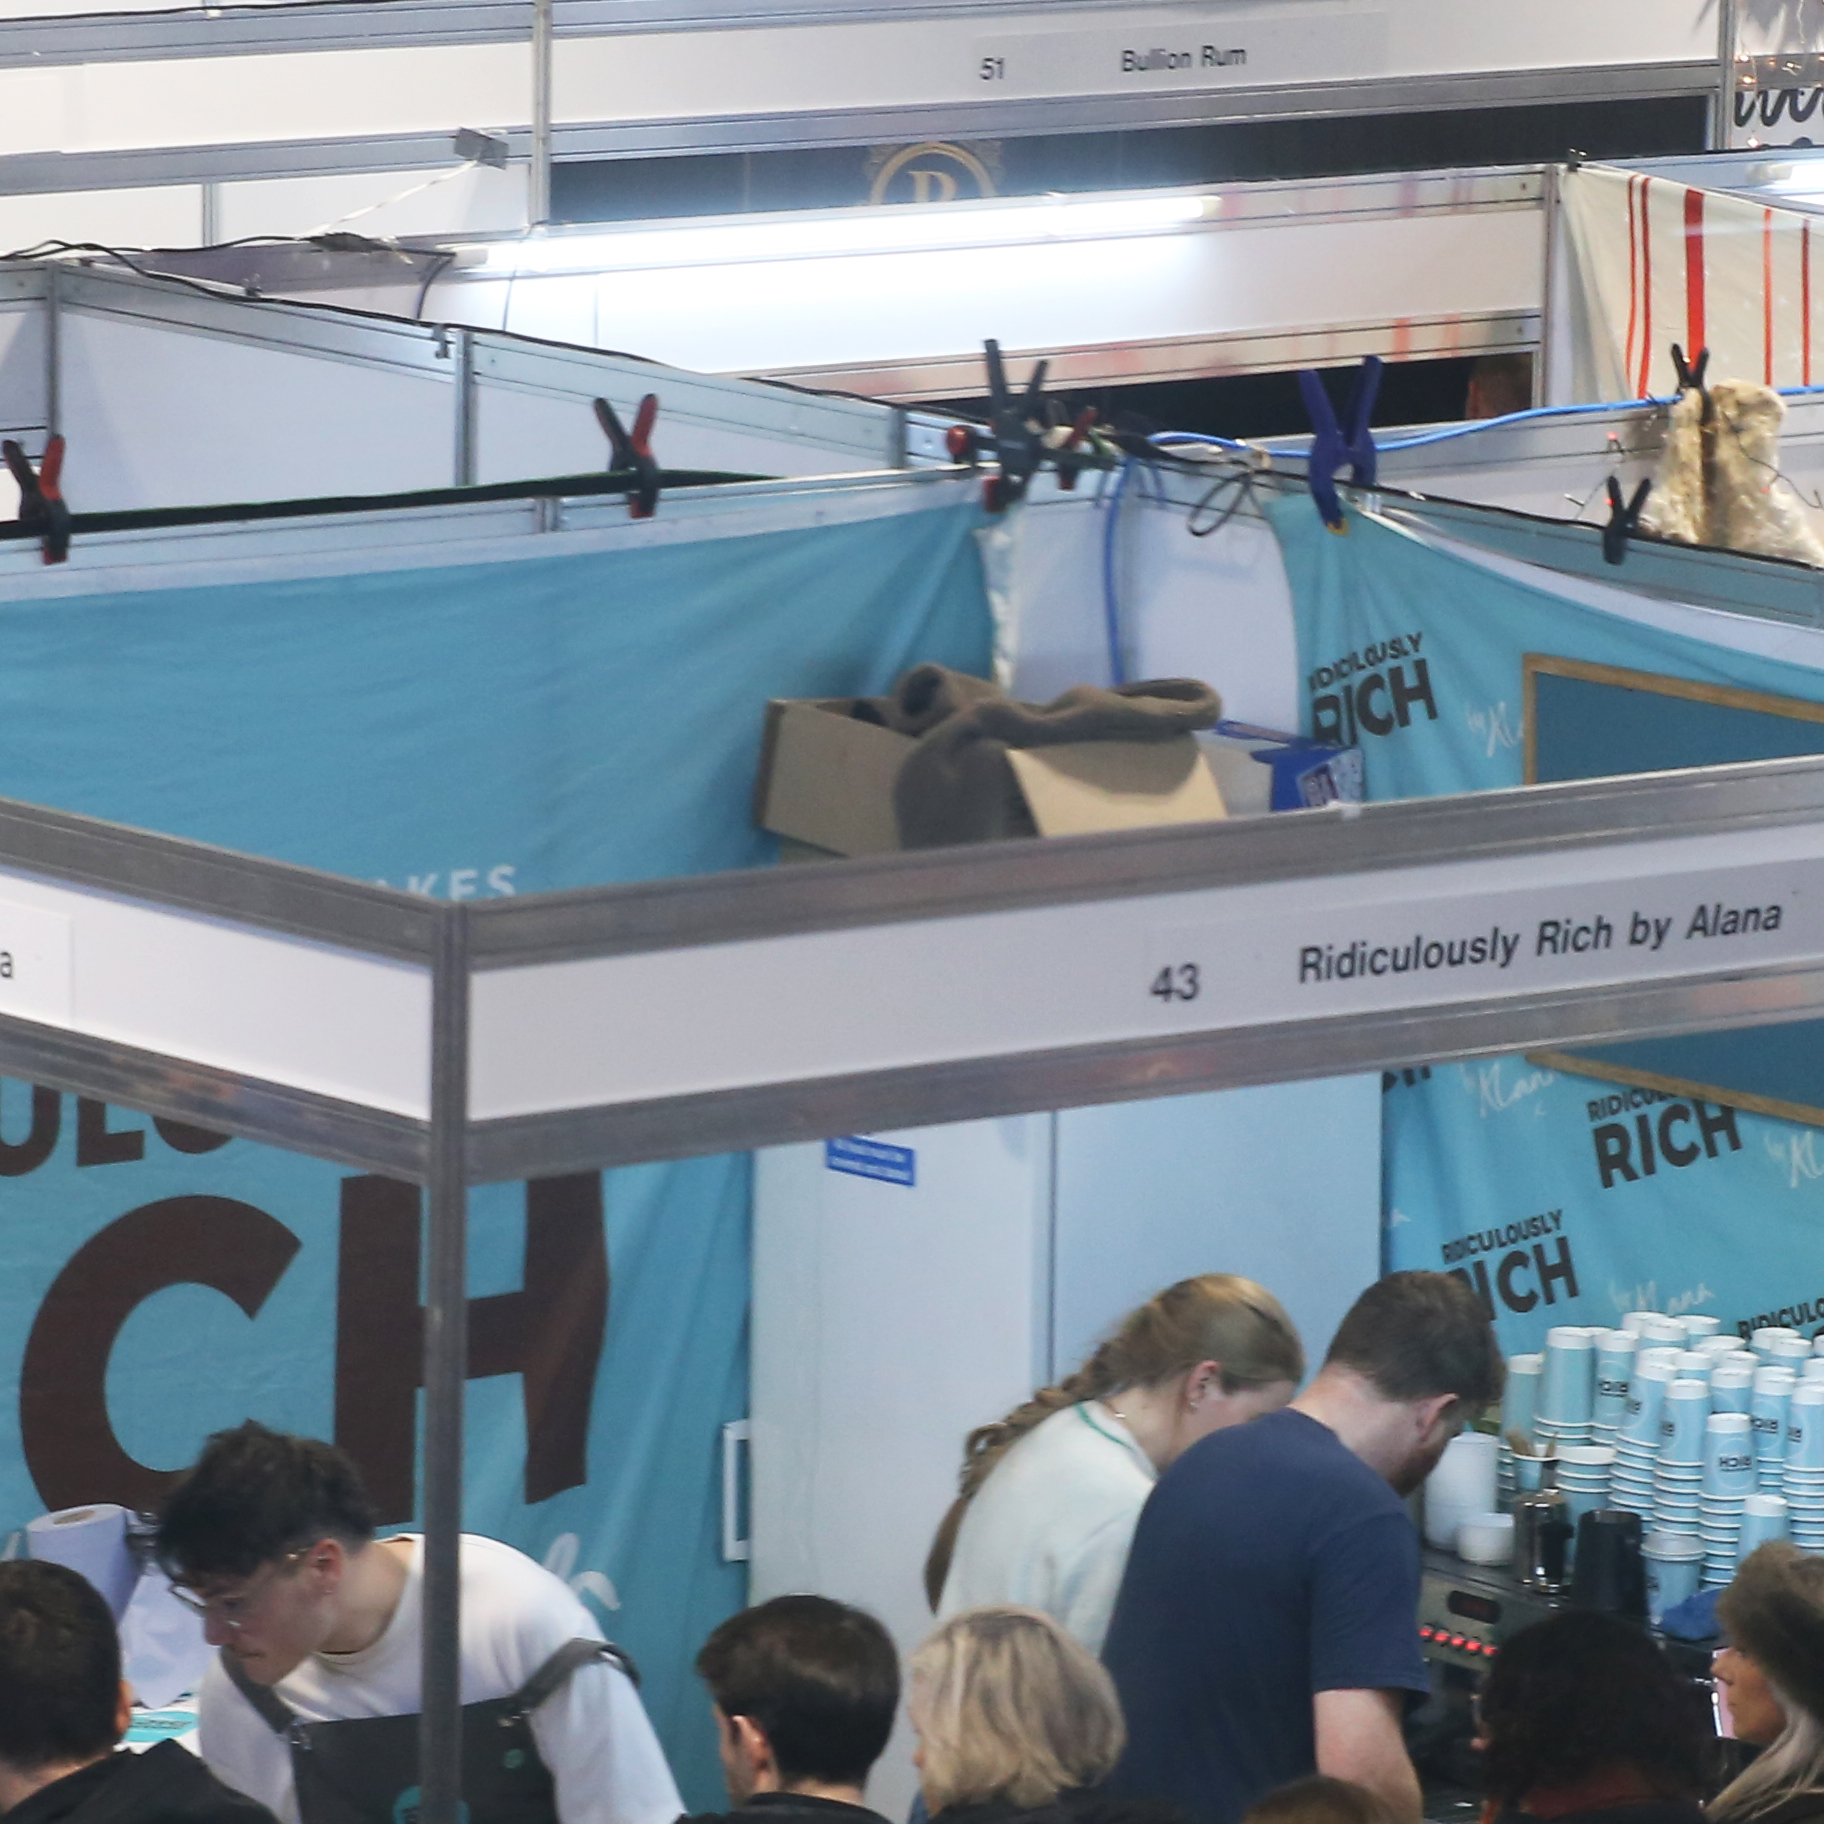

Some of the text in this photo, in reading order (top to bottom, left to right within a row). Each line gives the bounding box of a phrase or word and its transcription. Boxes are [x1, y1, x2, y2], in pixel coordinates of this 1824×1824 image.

[979, 44, 1247, 80] 51 Bullion Rum
[1313, 657, 1440, 747] RICH
[1150, 902, 1784, 1002] 43 Ridiculously Rich by Alana
[1592, 1098, 1743, 1190] RICH
[1440, 1208, 1564, 1265] RIDICULOUSLY
